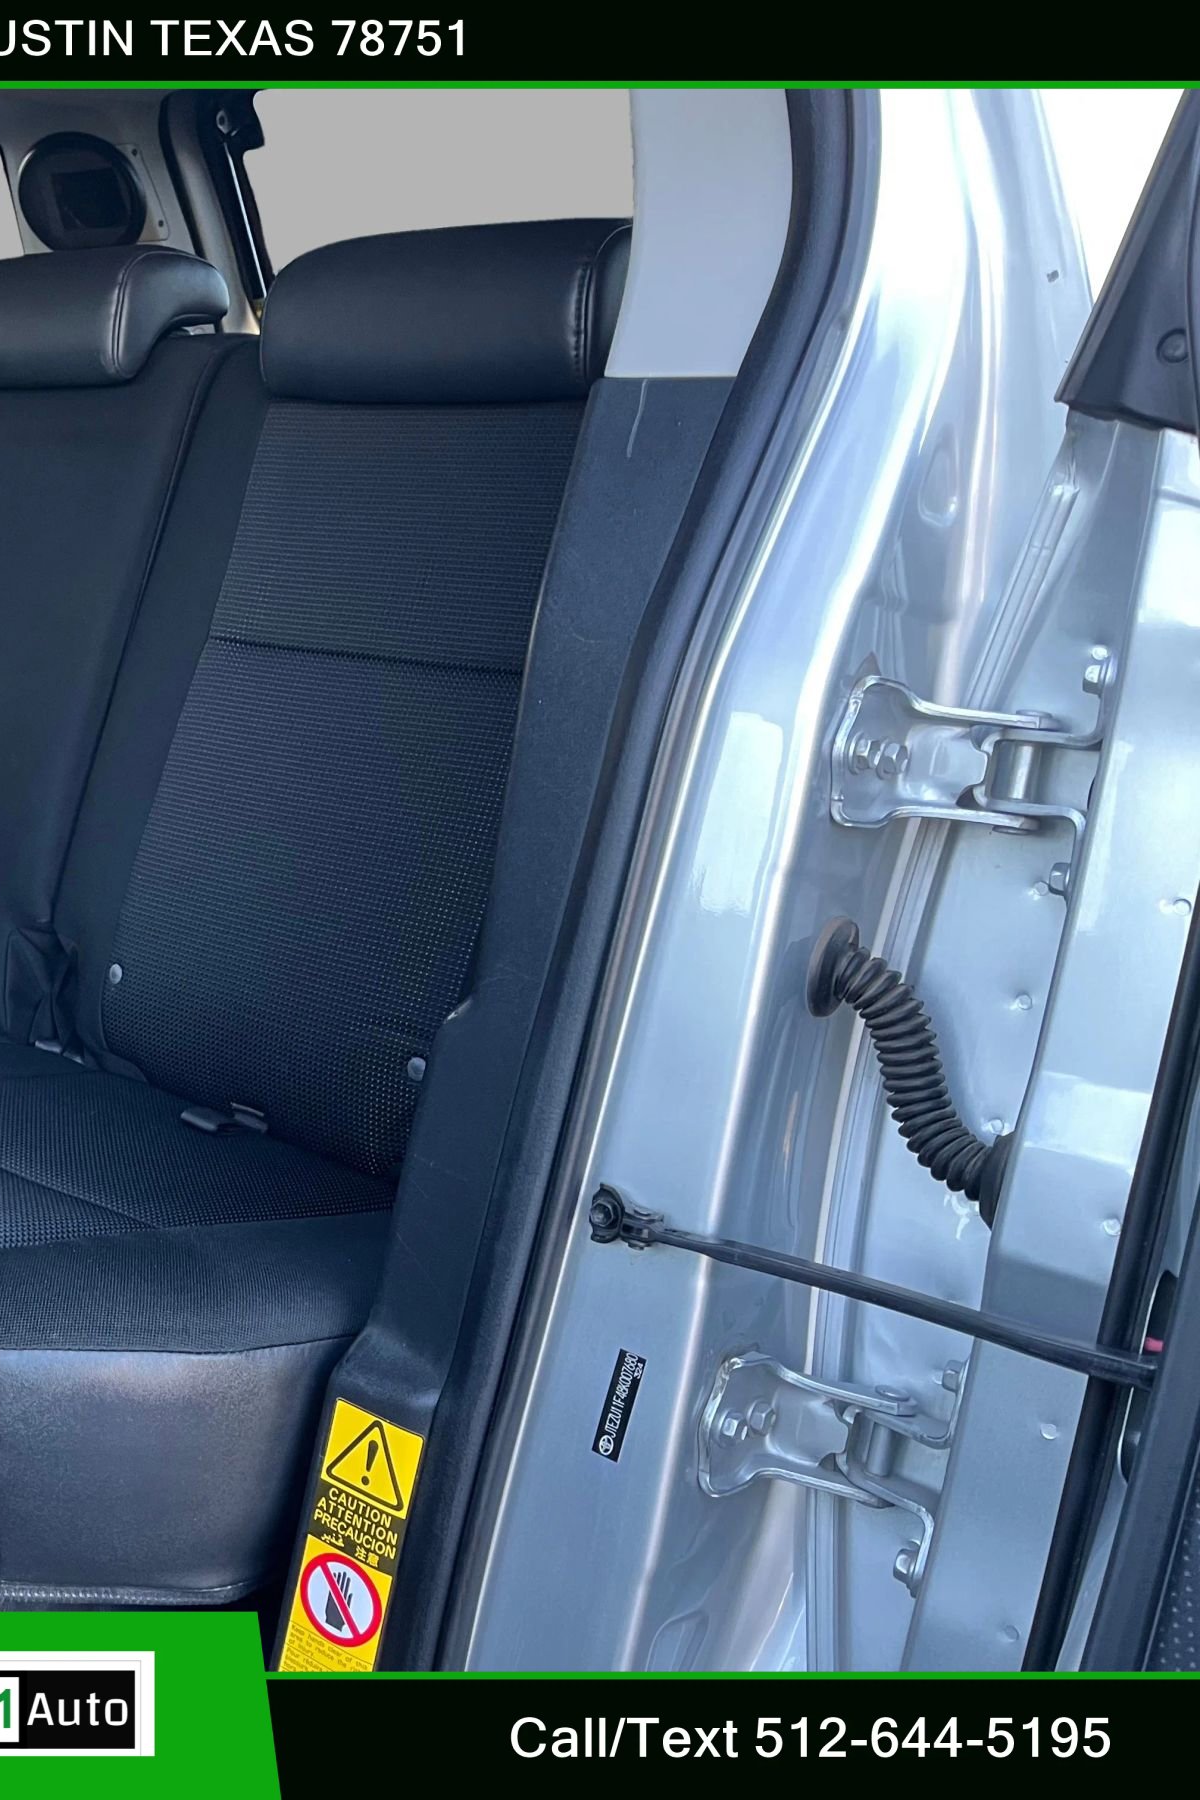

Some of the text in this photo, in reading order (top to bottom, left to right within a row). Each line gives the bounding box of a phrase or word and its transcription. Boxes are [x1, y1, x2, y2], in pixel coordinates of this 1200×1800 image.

[317, 1496, 398, 1546] ATTENTION
[329, 1487, 392, 1529] CAUTION
[313, 1508, 397, 1560] PRECAUCION
[354, 1545, 380, 1568] 注意
